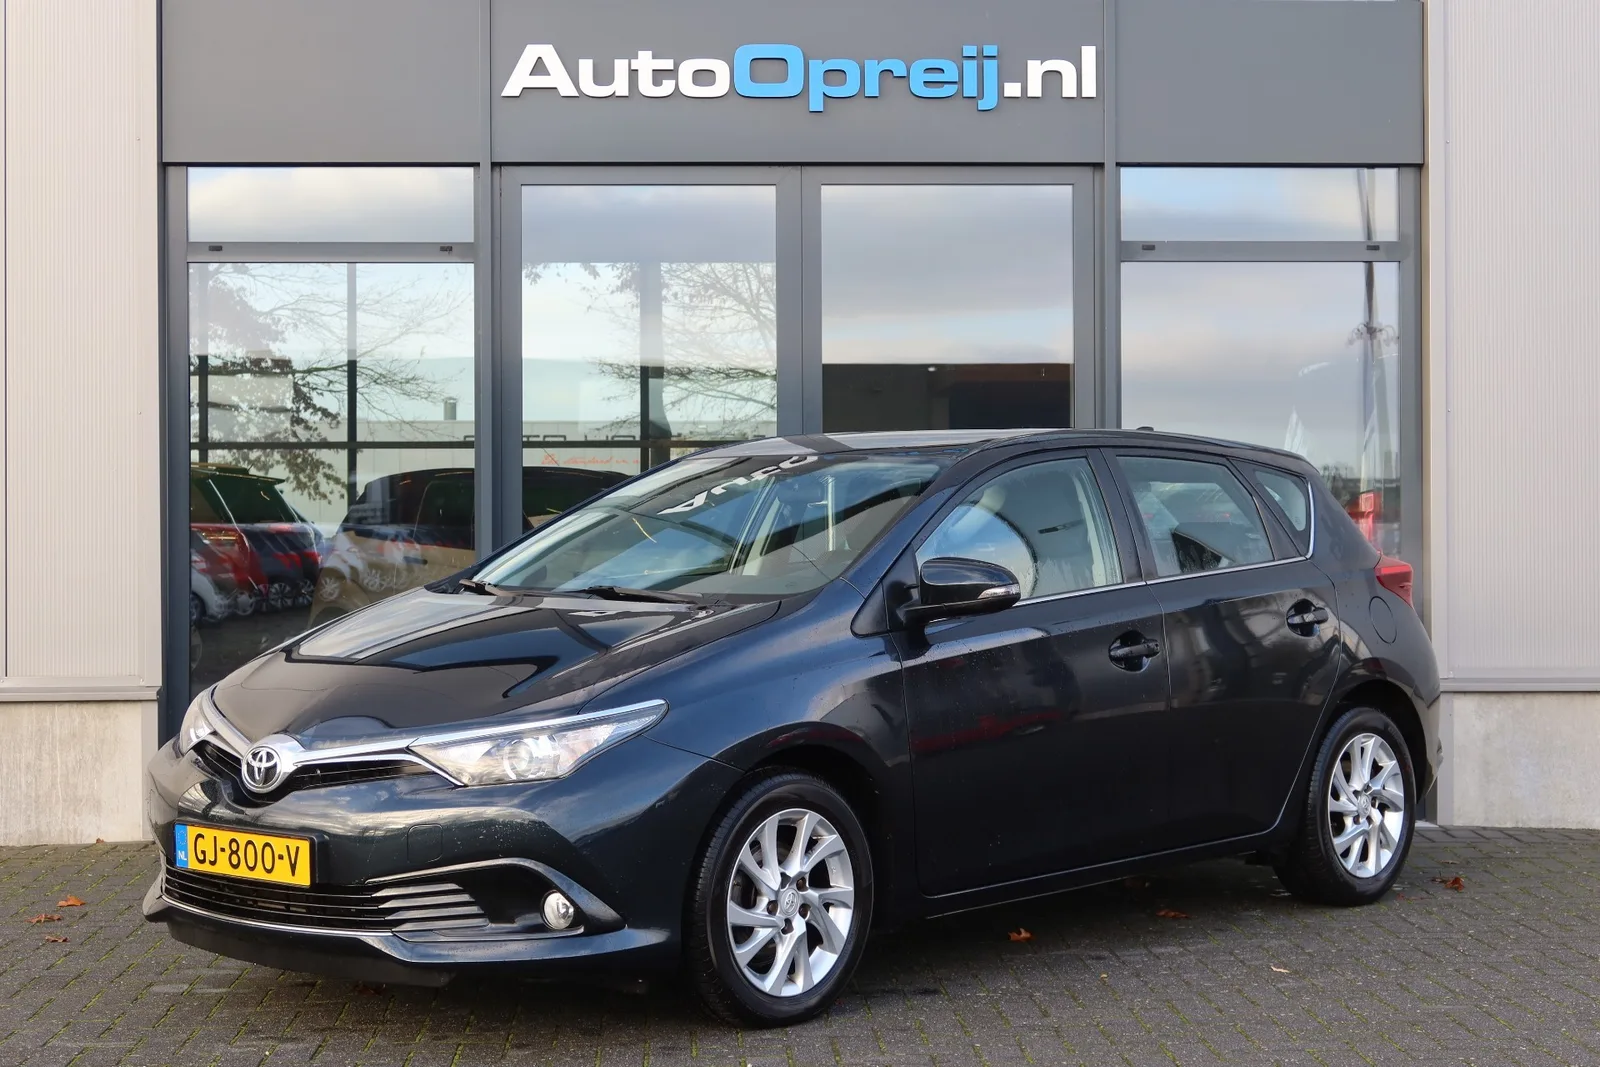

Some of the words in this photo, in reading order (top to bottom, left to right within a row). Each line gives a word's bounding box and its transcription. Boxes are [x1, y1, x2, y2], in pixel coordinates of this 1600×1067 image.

[501, 44, 1097, 112] AutoOpreij.nl
[178, 850, 188, 861] NL
[194, 833, 300, 877] GJ-800-V
